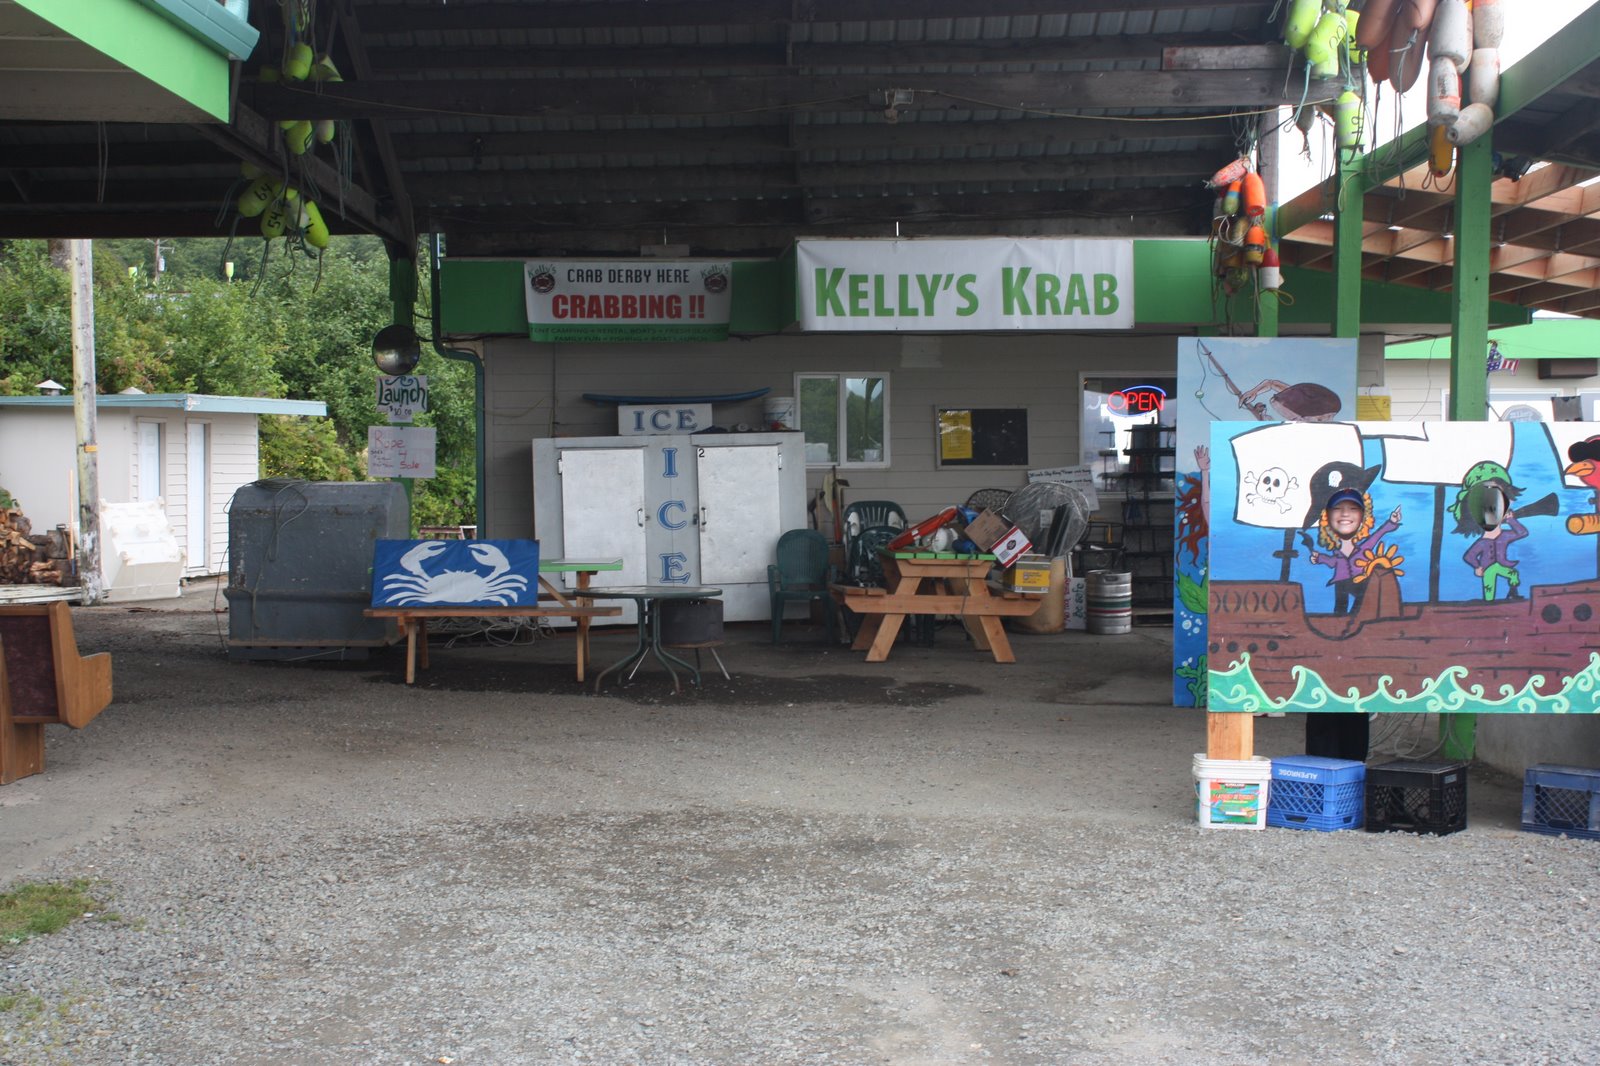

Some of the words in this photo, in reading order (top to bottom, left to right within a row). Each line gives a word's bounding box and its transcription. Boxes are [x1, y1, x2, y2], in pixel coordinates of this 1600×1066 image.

[567, 269, 602, 284] CRAB
[608, 269, 651, 284] DERBY
[657, 269, 690, 283] HERE
[814, 267, 980, 317] KELLY'S
[1001, 266, 1120, 316] KRAB
[551, 294, 682, 319] CRABBING
[688, 294, 705, 319] !!
[378, 377, 426, 410] Launch
[1107, 390, 1165, 411] OPEN
[633, 409, 698, 431] ICE
[698, 448, 705, 458] 2
[656, 448, 691, 584] ICE
